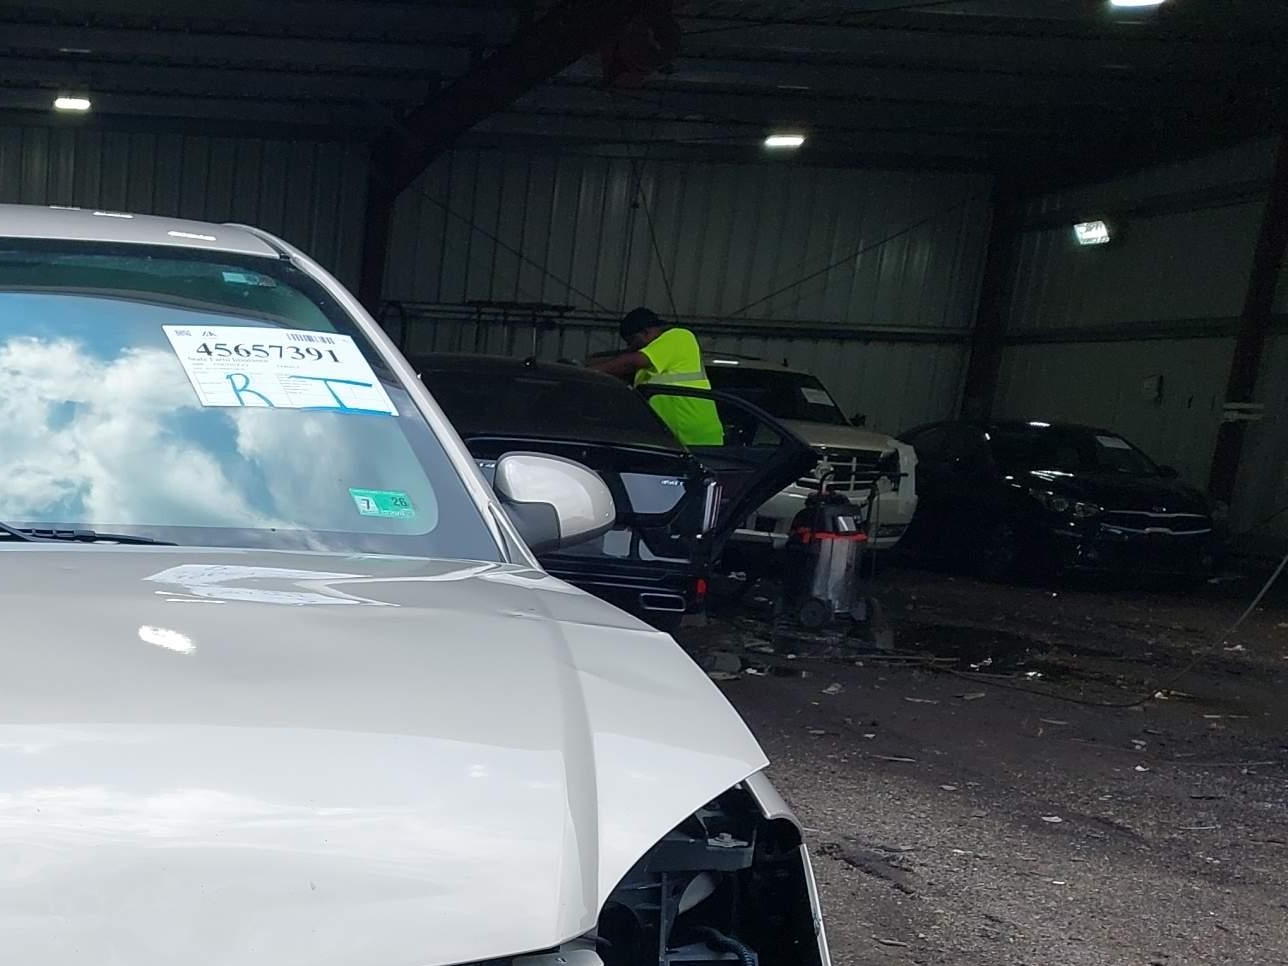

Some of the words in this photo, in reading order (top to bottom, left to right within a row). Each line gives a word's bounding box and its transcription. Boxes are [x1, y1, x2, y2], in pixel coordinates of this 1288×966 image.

[196, 342, 343, 364] 45657391
[225, 372, 275, 407] R
[391, 496, 409, 507] 26
